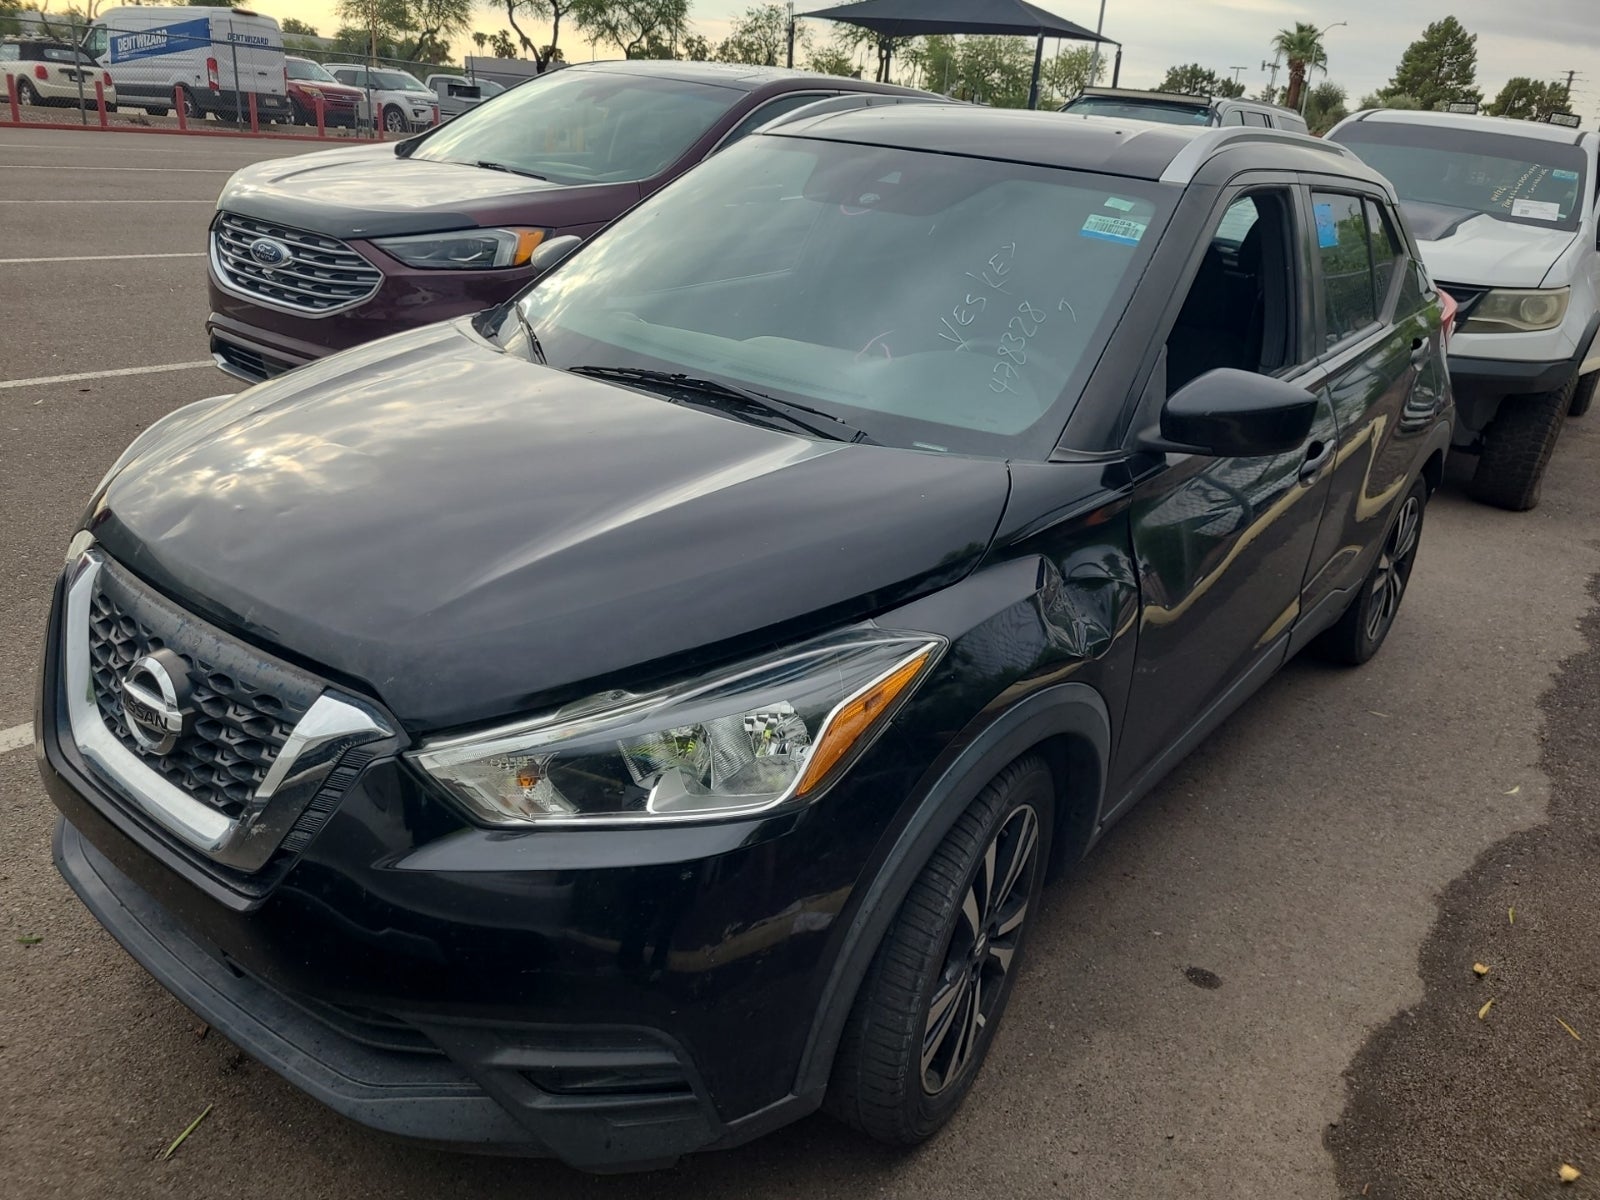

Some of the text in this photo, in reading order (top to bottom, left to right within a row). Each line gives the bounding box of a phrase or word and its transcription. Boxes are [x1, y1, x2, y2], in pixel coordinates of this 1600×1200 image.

[117, 34, 136, 52] DENT
[136, 29, 168, 49] WIZARD
[227, 32, 269, 45] DENT WIZARD
[938, 241, 1016, 352] YES KEY
